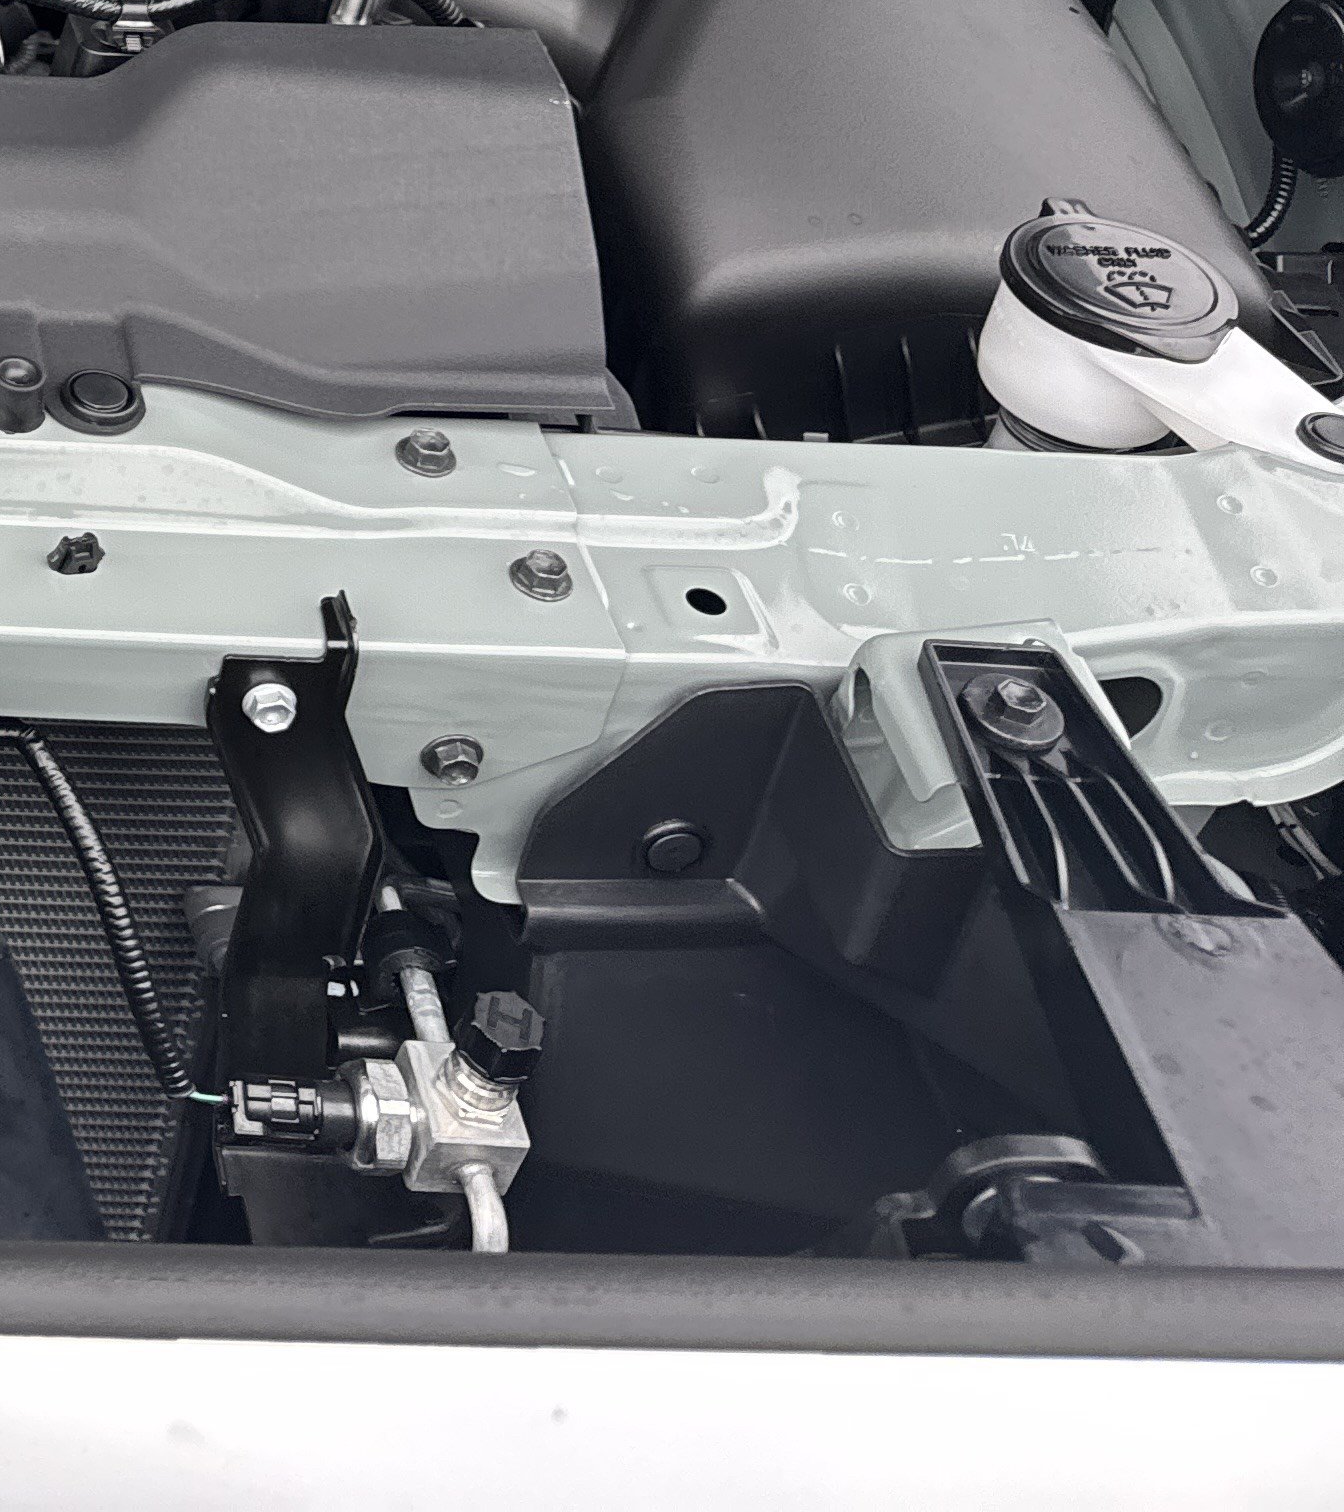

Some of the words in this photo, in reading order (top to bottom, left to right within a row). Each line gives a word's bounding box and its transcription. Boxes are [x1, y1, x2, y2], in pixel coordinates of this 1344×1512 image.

[1046, 245, 1119, 257] WASHER
[1124, 246, 1172, 259] FLUID
[1097, 257, 1137, 268] ONLY
